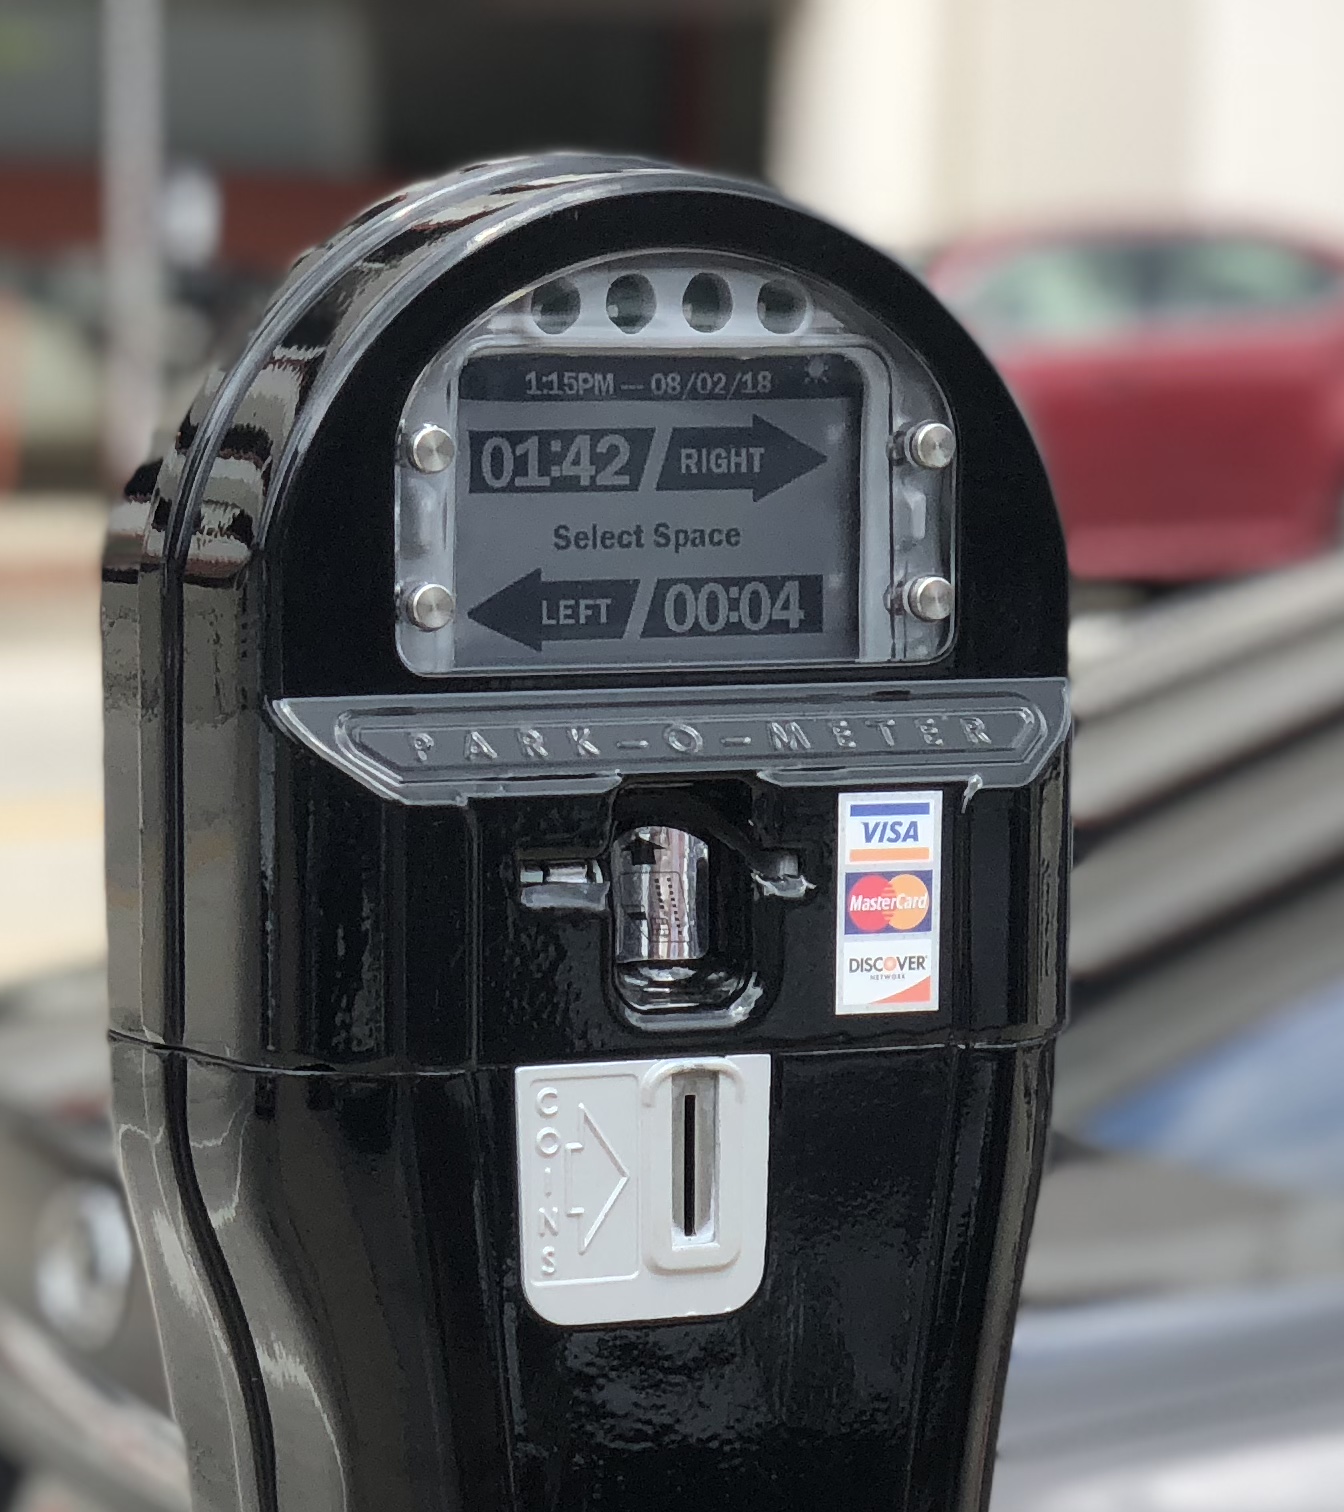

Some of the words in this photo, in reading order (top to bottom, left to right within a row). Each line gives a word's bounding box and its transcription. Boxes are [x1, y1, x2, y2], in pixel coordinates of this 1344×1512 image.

[525, 370, 615, 396] 1:15PM
[650, 370, 773, 400] 08/02/18
[481, 434, 631, 488] 01:42
[680, 446, 765, 475] RIGHT
[553, 524, 645, 551] Select
[653, 523, 742, 553] Space
[541, 598, 612, 626] LEFT
[663, 580, 805, 634] 00:04
[411, 714, 992, 764] PARK-O-METER
[861, 821, 919, 843] VISA
[850, 892, 928, 911] MasterCard
[848, 955, 928, 974] DISCOVER
[869, 972, 906, 981] NETWORK
